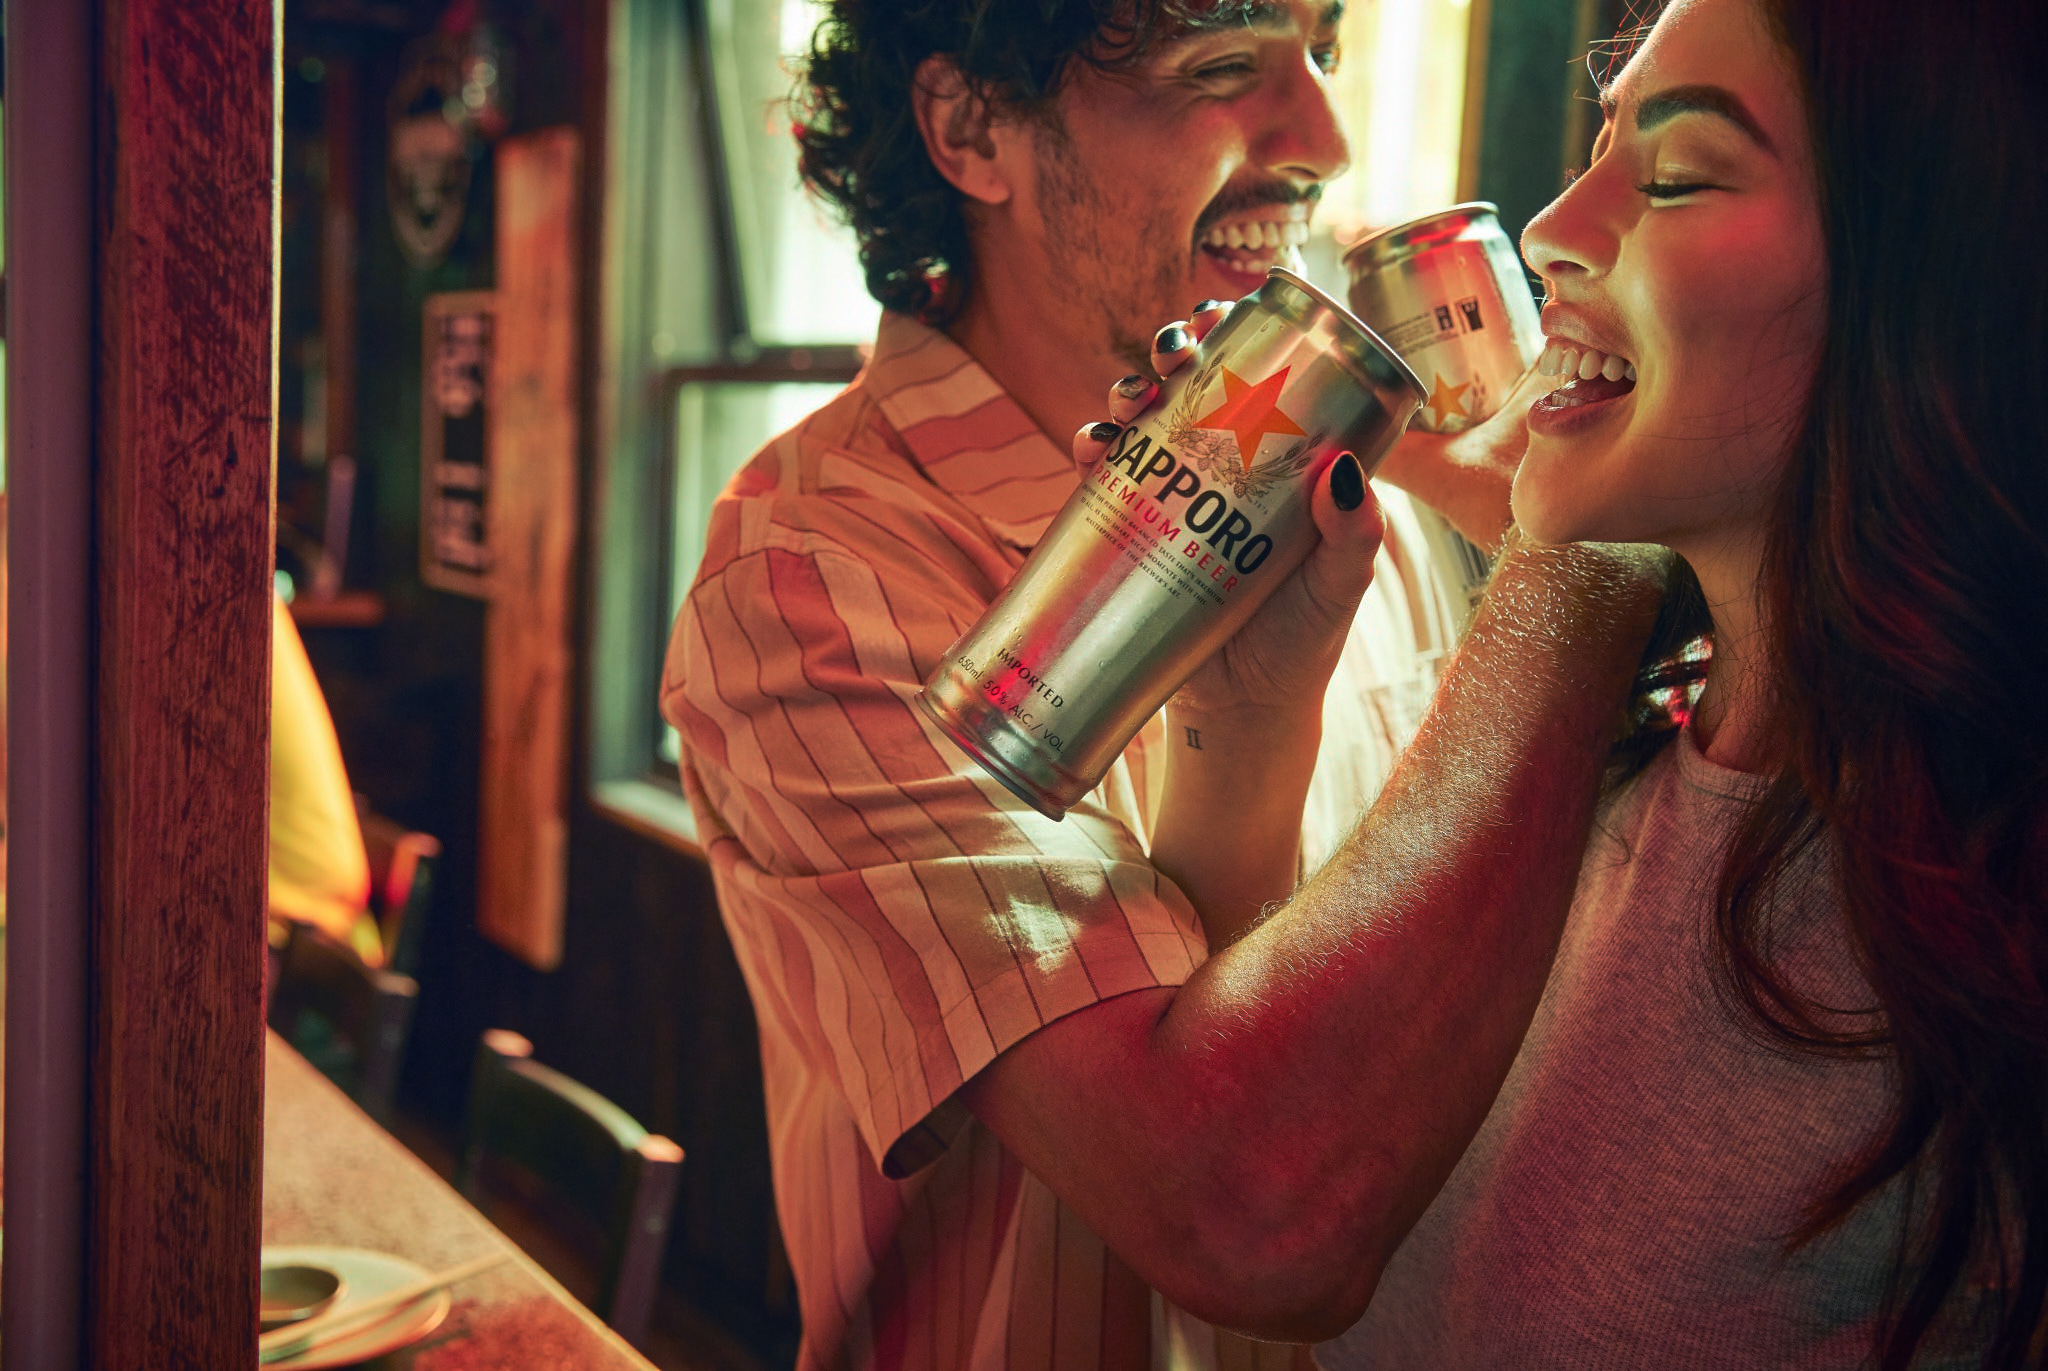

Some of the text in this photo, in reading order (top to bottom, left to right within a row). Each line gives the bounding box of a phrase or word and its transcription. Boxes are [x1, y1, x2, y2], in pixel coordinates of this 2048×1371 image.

[1094, 465, 1239, 593] PREMIUM BEER
[1105, 425, 1273, 575] SAPPORO
[1128, 521, 1159, 548] BALANCED
[1159, 546, 1176, 562] TASTE
[1147, 551, 1178, 580] MOMENTS
[997, 648, 1064, 709] IMPORTED
